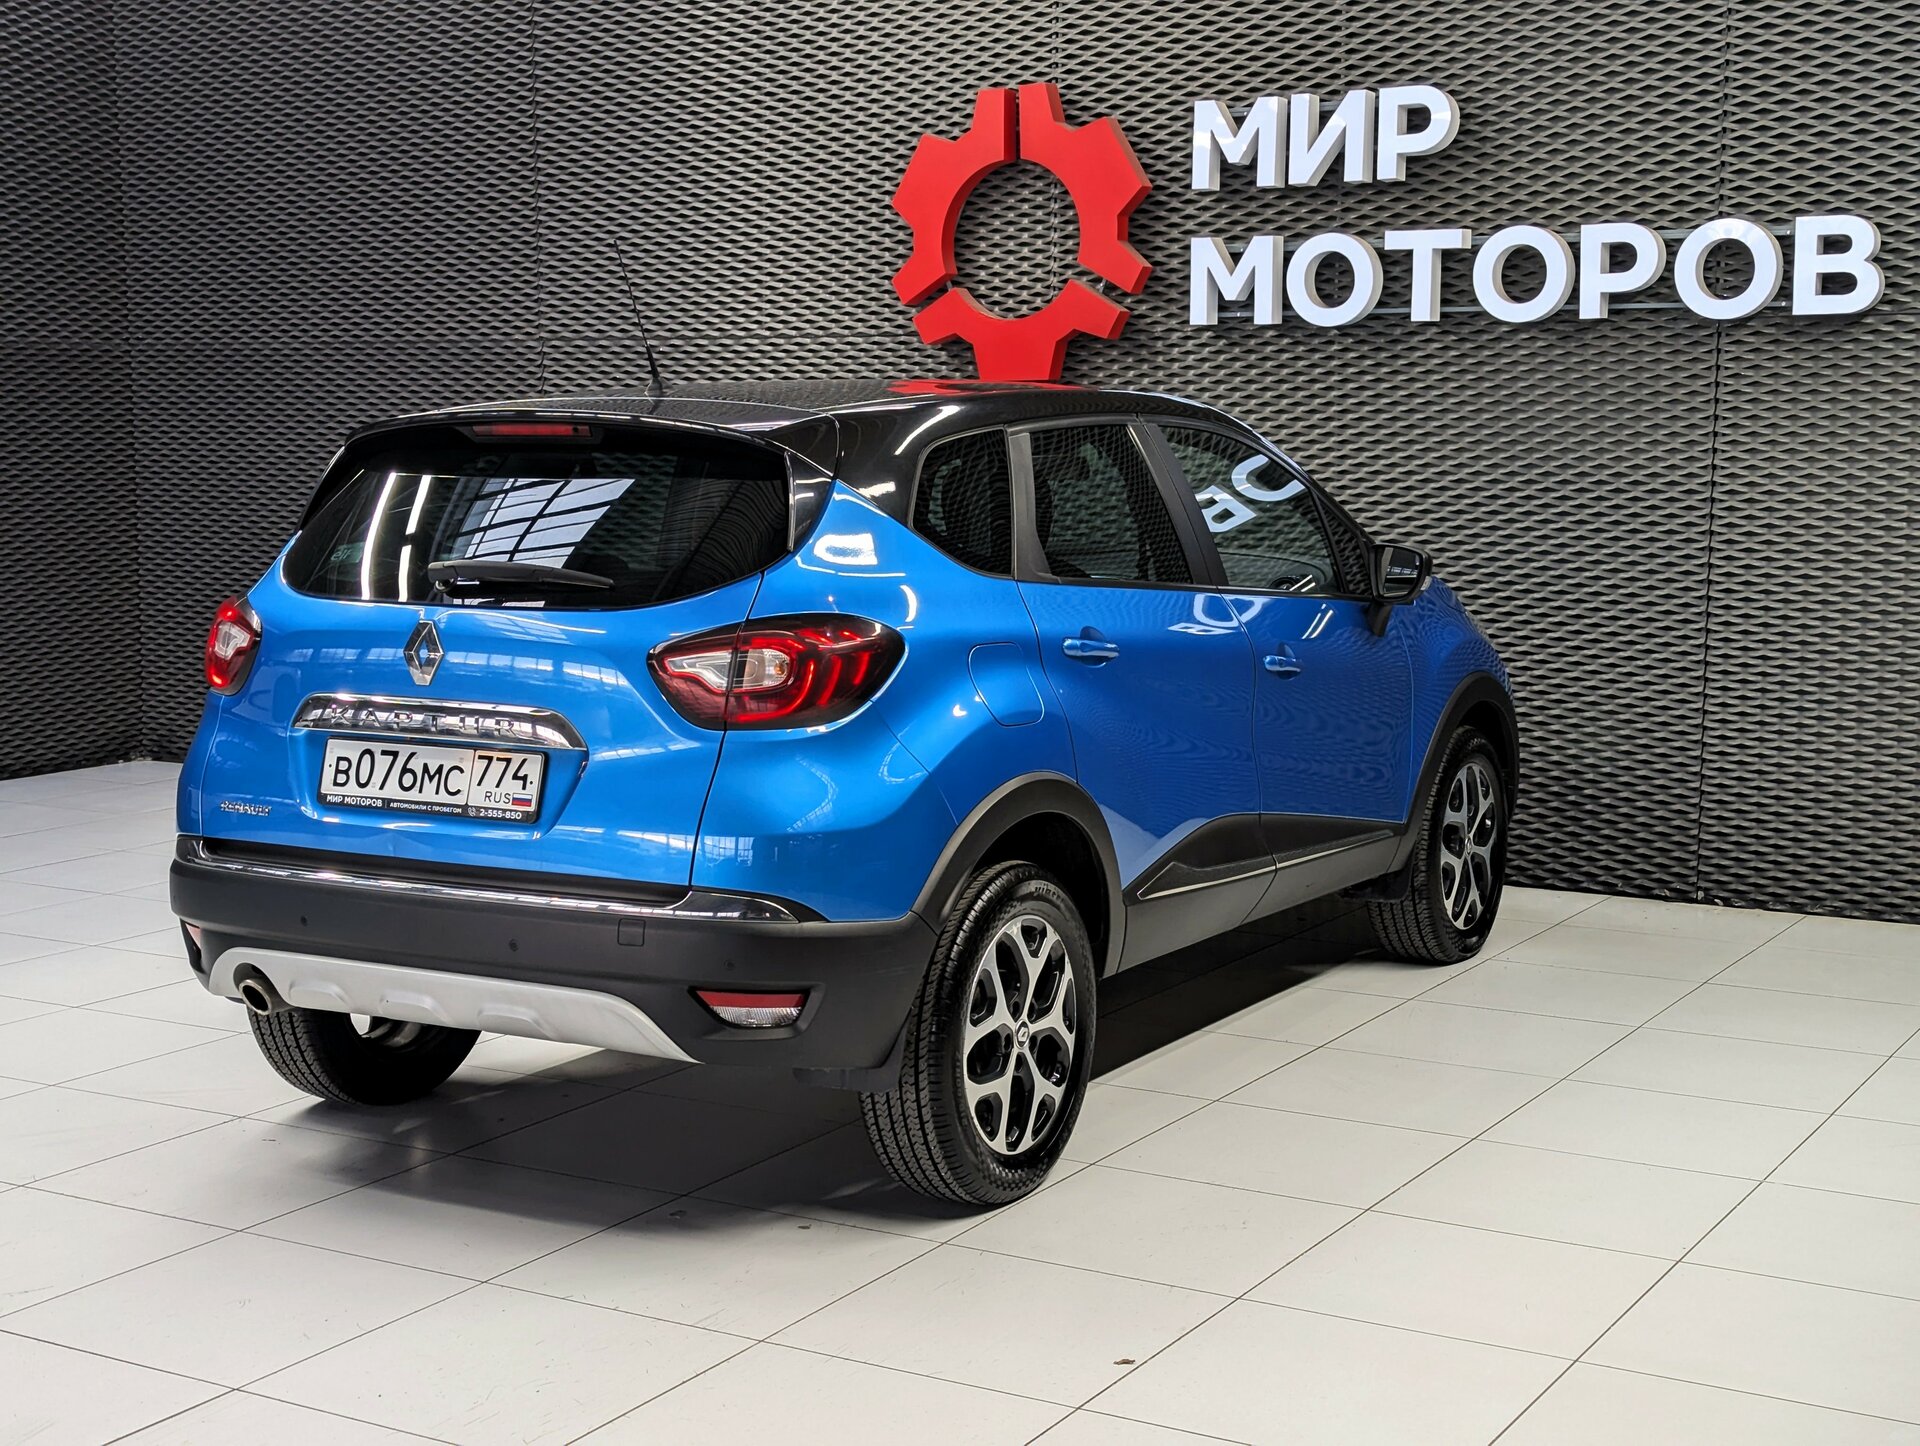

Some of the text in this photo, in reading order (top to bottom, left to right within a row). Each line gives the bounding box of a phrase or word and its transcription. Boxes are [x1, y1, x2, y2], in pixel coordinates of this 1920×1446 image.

[1191, 85, 1460, 191] МИР
[1189, 215, 1886, 327] МОТОРОВ
[333, 748, 530, 797] В076МС 774
[326, 795, 343, 803] МИР
[344, 797, 383, 807] МОТОРОВ
[389, 802, 427, 811] АВТОМОБИЛИ
[479, 808, 522, 820] 2-555-850
[484, 791, 512, 804] RUS
